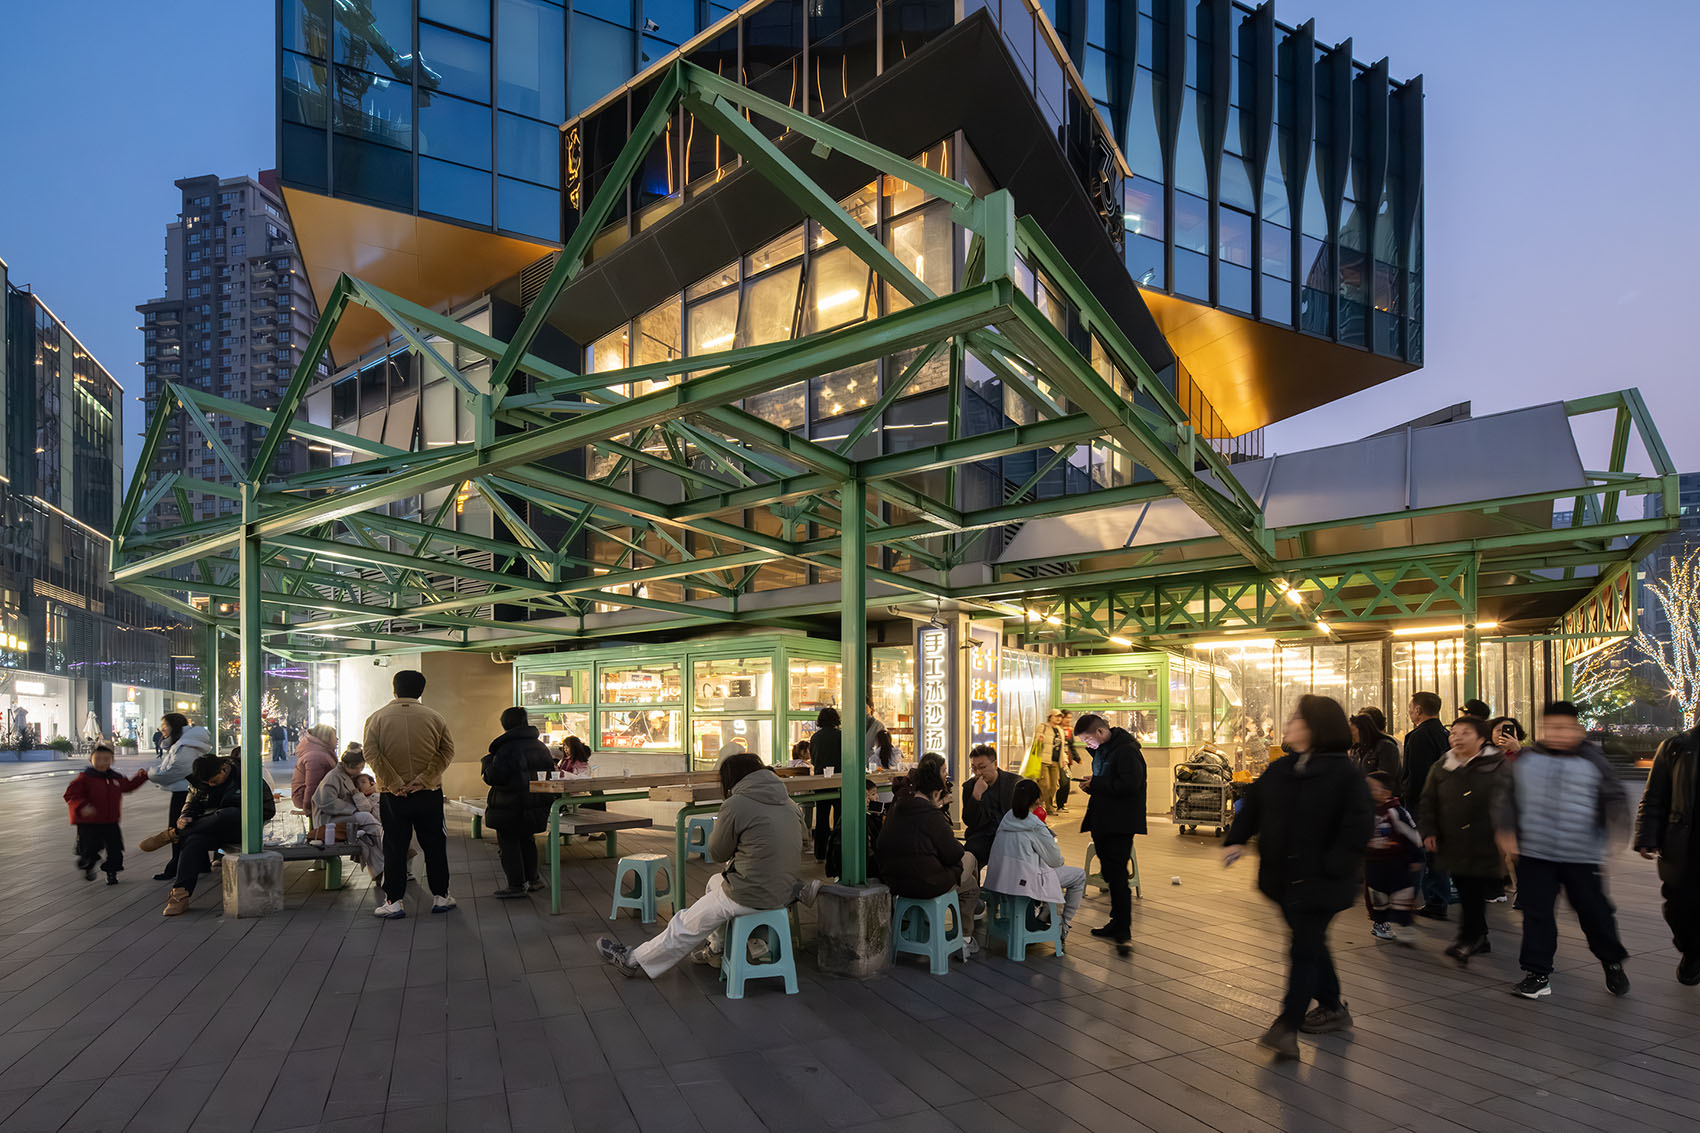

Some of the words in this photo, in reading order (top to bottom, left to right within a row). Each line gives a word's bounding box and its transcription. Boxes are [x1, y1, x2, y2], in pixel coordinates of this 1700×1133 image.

[924, 632, 945, 756] 手工冰沙汤
[972, 647, 985, 748] 古法手
